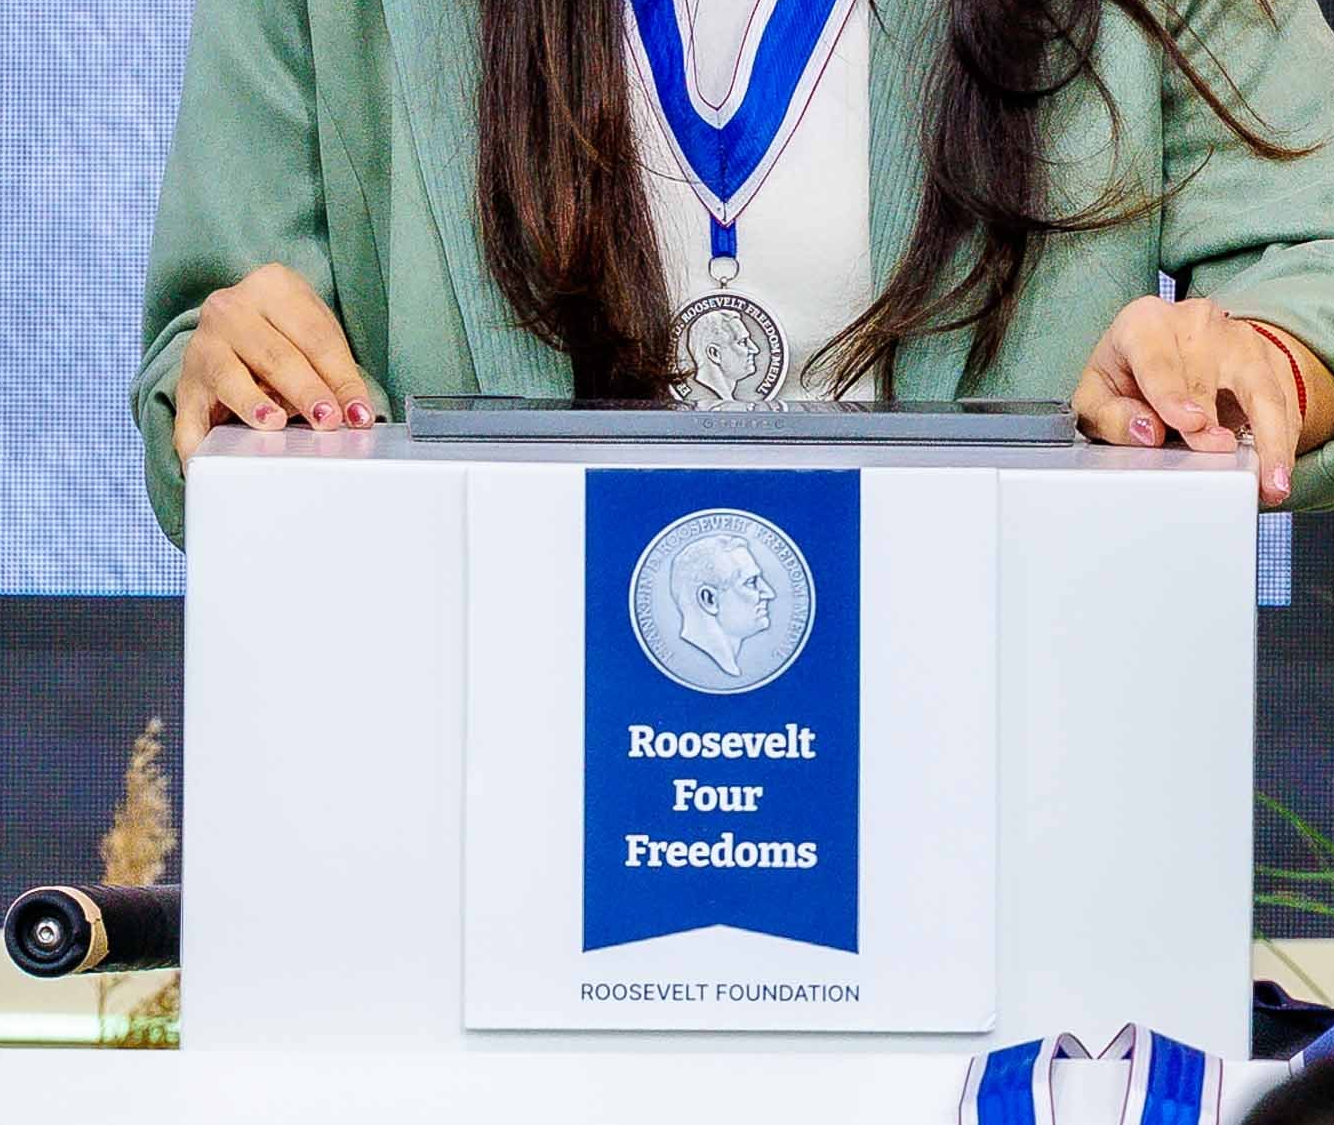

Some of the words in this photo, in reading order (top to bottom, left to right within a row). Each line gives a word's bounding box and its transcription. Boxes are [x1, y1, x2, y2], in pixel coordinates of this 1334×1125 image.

[682, 297, 746, 323] ROOSEVELT
[745, 304, 782, 354] FREEDOM
[757, 356, 782, 395] MEDAL
[628, 723, 816, 759] Roosevelt
[672, 779, 764, 812] Four
[625, 832, 818, 868] Freedoms
[580, 983, 709, 1002] ROOSEVELT
[716, 983, 860, 1003] FOUNDATION
